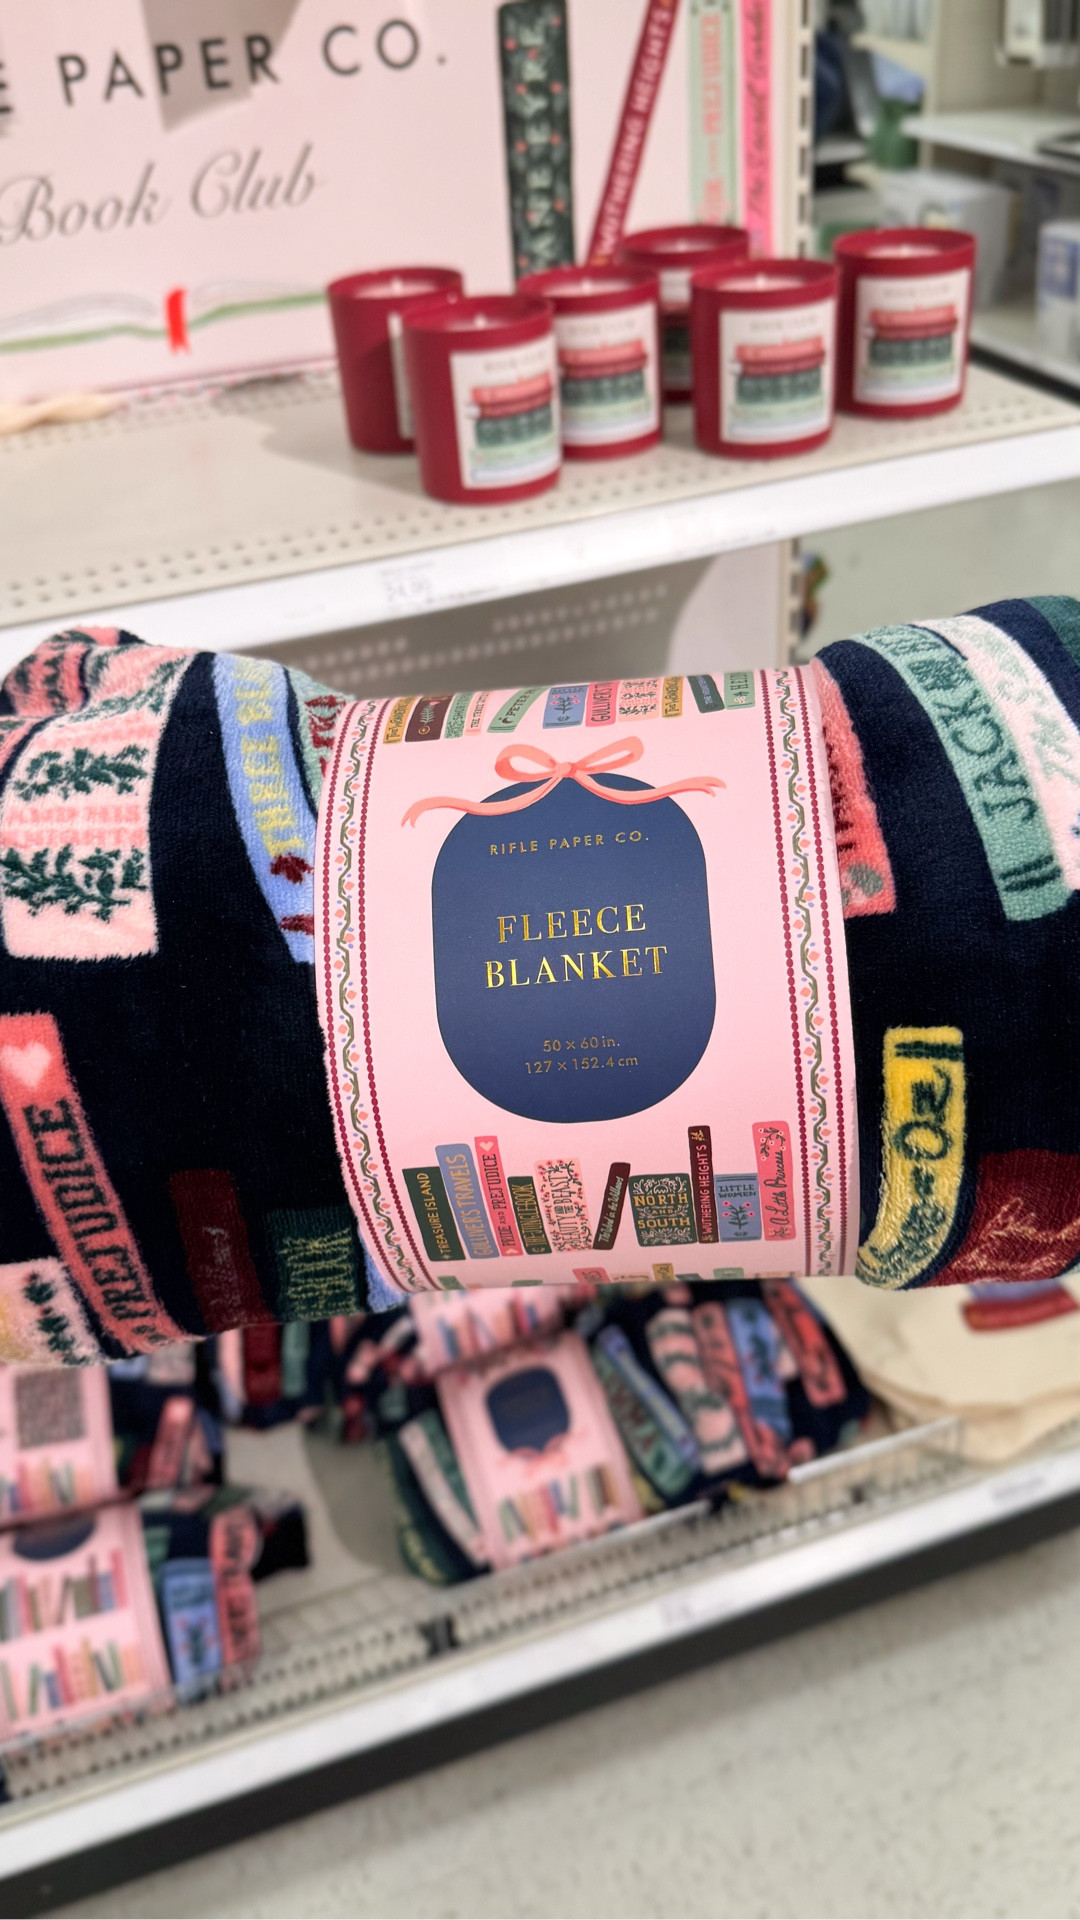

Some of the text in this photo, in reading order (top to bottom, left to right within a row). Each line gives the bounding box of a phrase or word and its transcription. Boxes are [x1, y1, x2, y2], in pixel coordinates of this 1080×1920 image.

[57, 34, 280, 106] PAPER
[322, 19, 447, 77] CO.
[597, 4, 672, 258] WUTHERING HEIGHTS
[0, 142, 322, 248] Book Club
[932, 686, 1038, 823] JACK
[239, 732, 306, 858] THREE
[489, 830, 650, 856] RIFLE PAPER CO.
[496, 903, 647, 944] FLEECE
[484, 945, 668, 989] BLANKET
[525, 1060, 552, 1074] 127
[572, 1056, 615, 1072] 152.4
[617, 1056, 639, 1067] cm
[543, 1040, 562, 1053] 50
[580, 1037, 599, 1050] 60
[445, 1154, 477, 1208] TRAVELS
[482, 1153, 507, 1210] PREJUDICE
[547, 1175, 573, 1204] BEAST
[718, 1183, 756, 1193] LITTLE
[763, 1149, 788, 1189] Princess
[23, 1096, 157, 1321] PREJUDICE
[632, 1193, 689, 1208] NORTH
[695, 1144, 713, 1236] WUTHERING HEIGHTS
[718, 1191, 757, 1199] WOMEN
[764, 1190, 790, 1217] Little
[416, 1172, 451, 1254] TREASURE ISLAND
[637, 1217, 691, 1230] SOUTH
[498, 1225, 516, 1247] PRIDE
